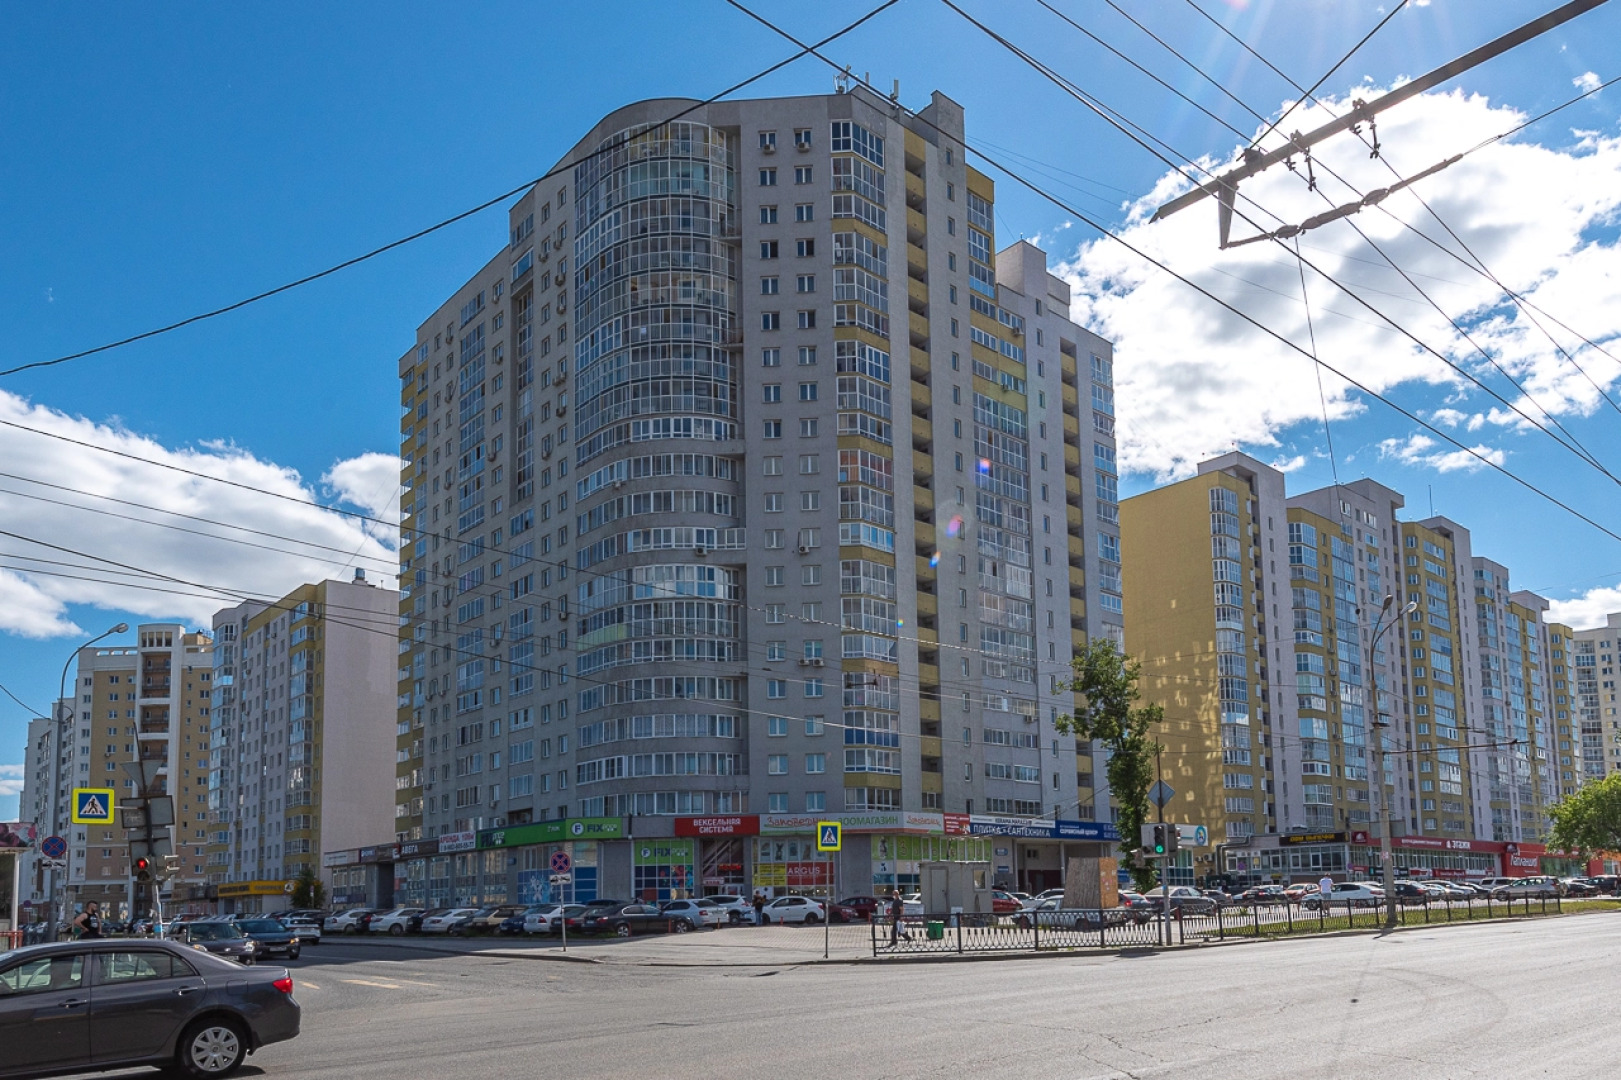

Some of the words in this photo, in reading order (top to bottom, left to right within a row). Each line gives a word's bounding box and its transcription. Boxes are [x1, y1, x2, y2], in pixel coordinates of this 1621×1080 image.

[693, 818, 741, 827] ВЕКСЕЛЬНАЯ
[587, 823, 603, 831] FIX
[654, 848, 671, 857] FIX
[788, 867, 820, 875] ARGUS
